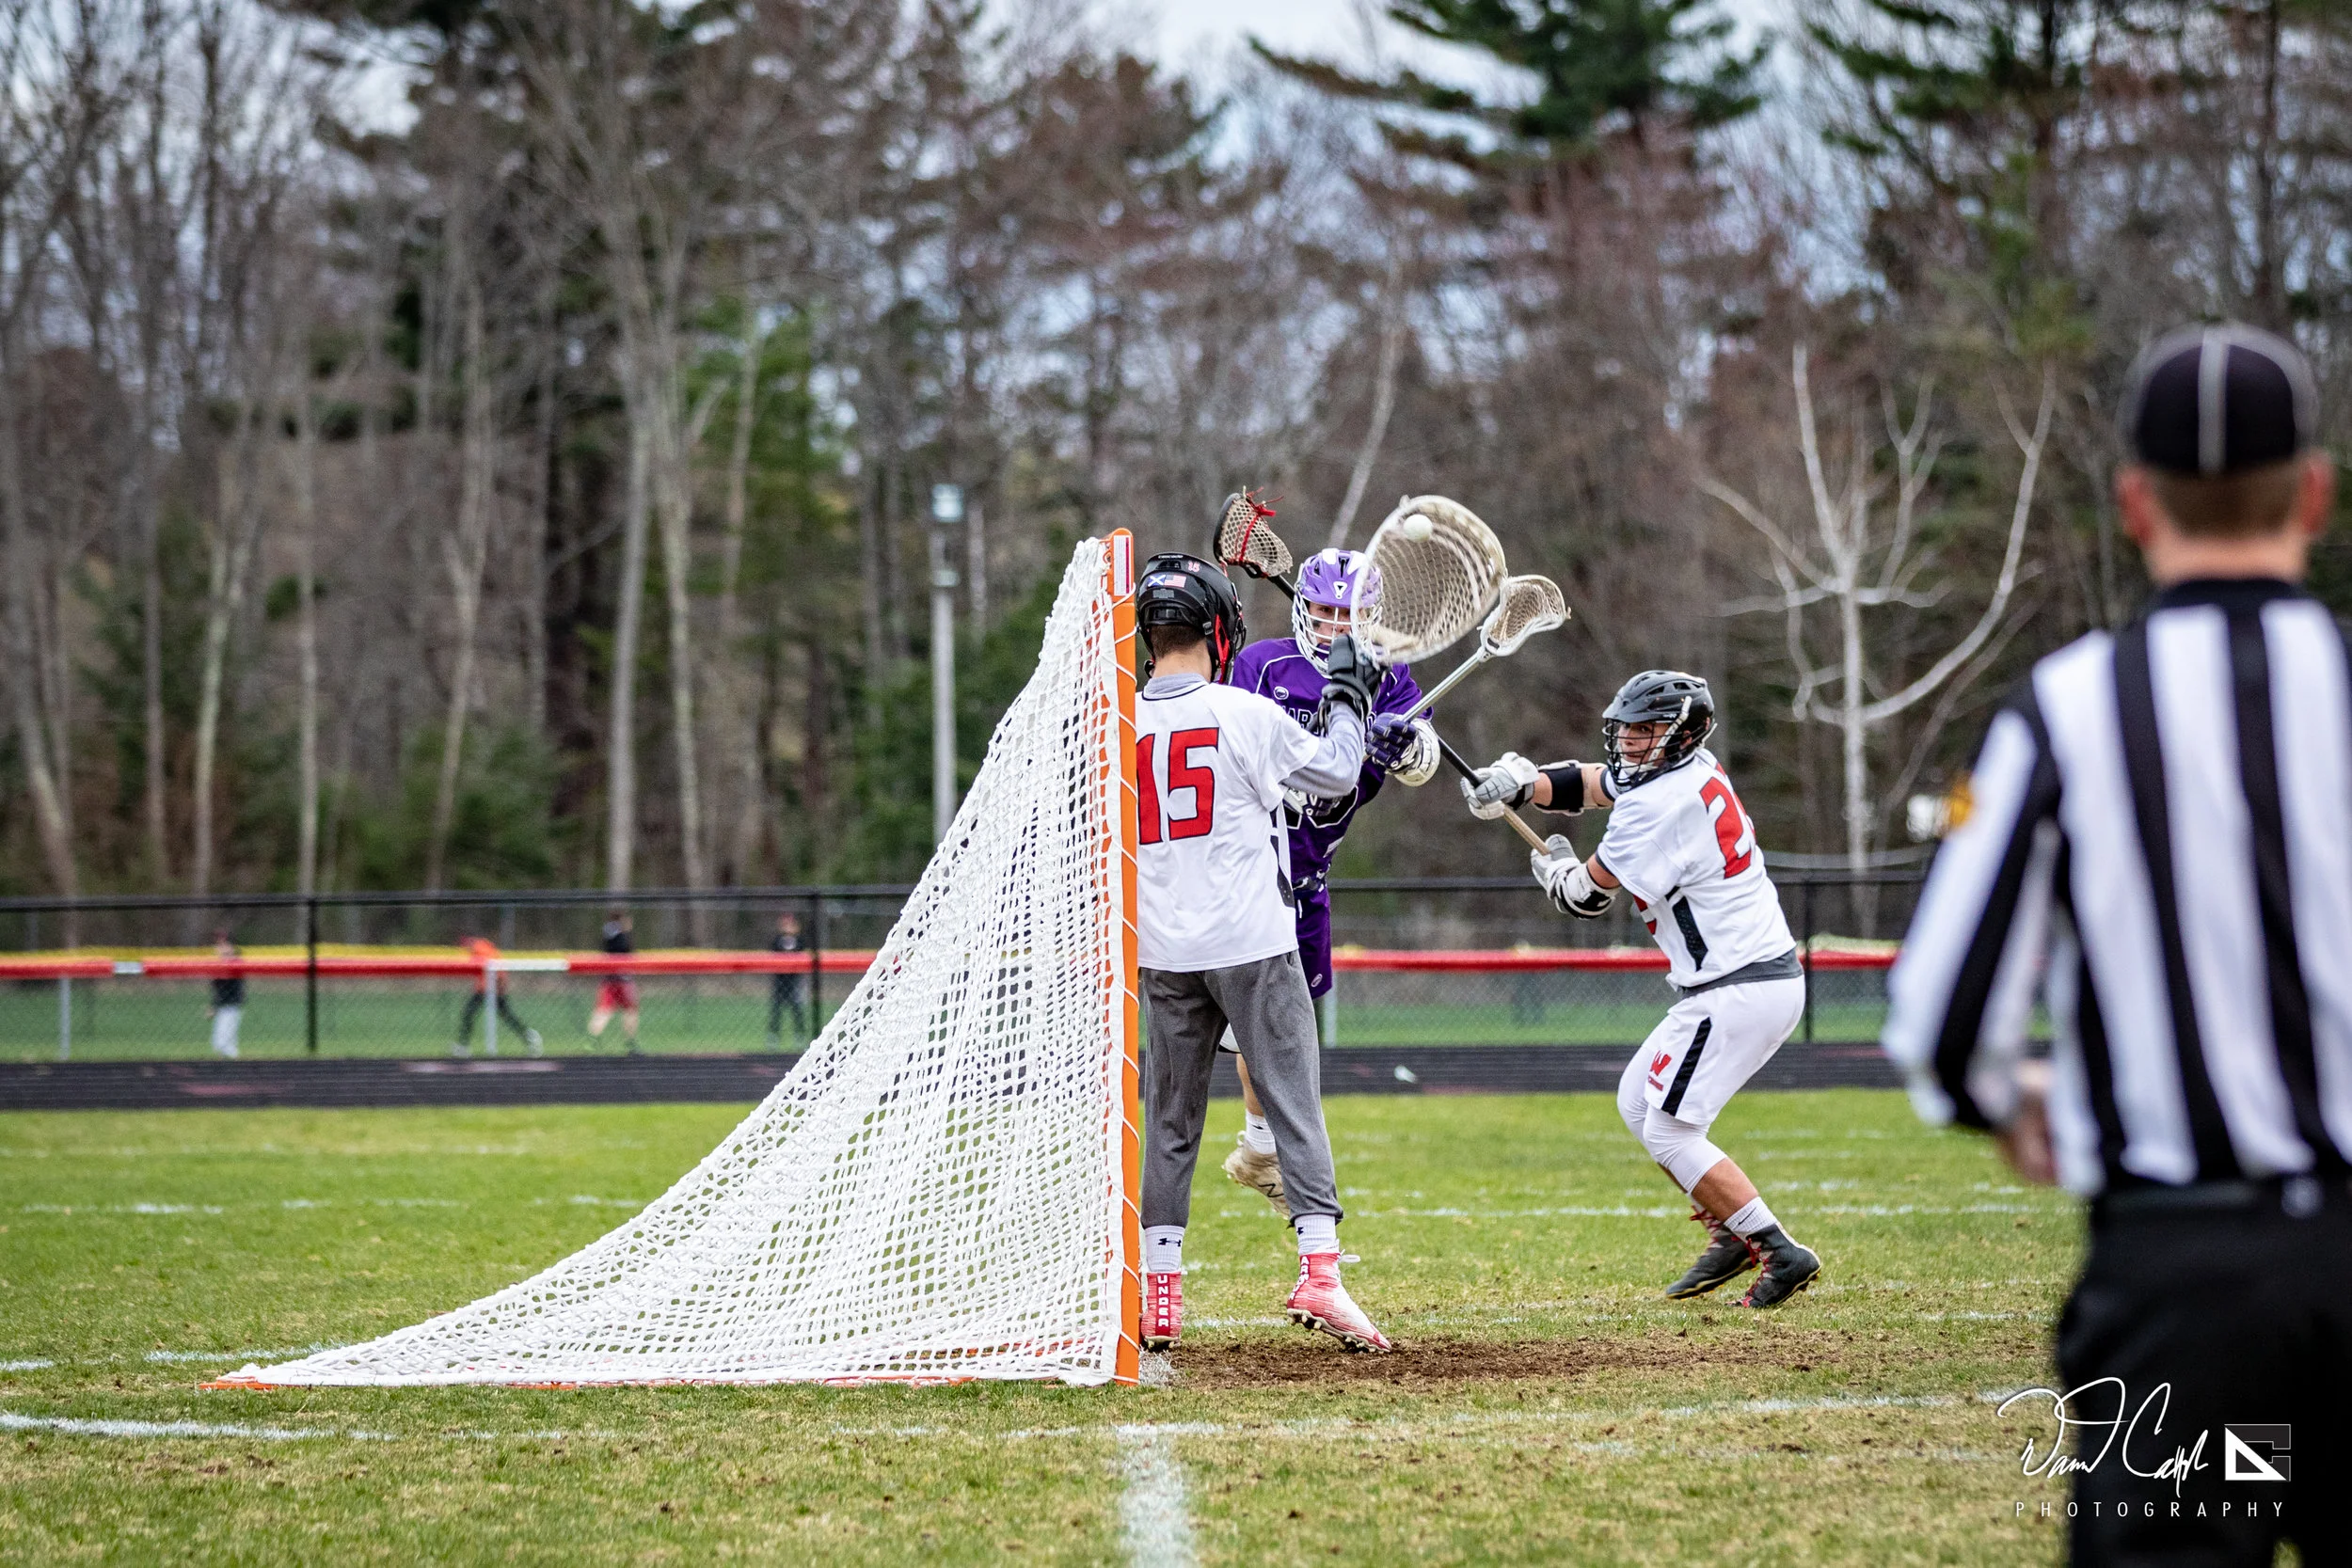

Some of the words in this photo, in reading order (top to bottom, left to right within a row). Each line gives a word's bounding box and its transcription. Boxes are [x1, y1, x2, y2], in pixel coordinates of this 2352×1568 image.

[1187, 560, 1200, 573] 15
[1136, 726, 1220, 846] 15
[1157, 1275, 1169, 1327] UNDER
